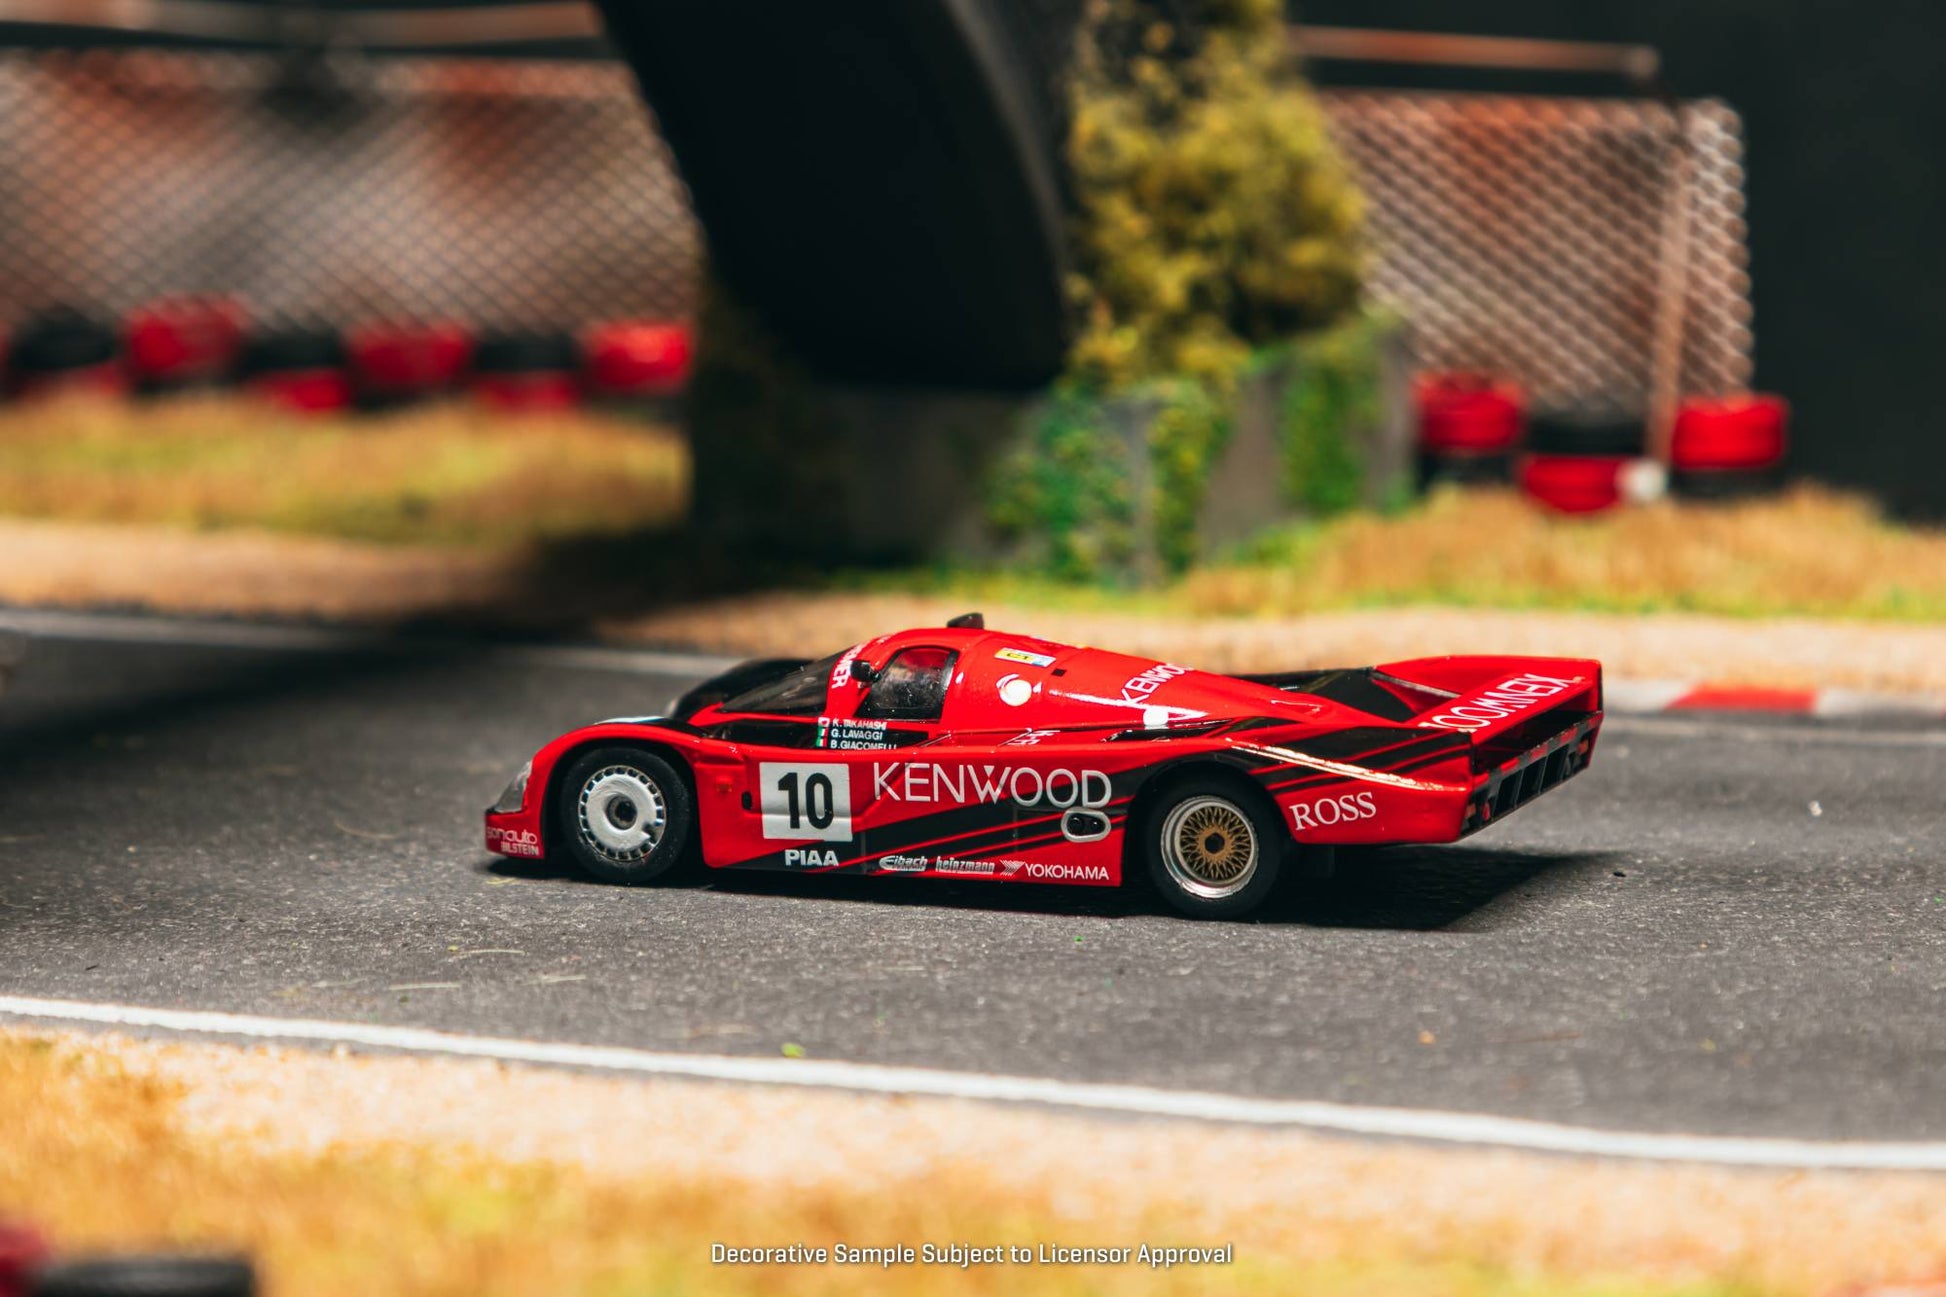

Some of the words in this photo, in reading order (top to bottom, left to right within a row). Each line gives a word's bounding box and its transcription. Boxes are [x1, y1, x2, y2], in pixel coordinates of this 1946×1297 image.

[842, 729, 883, 740] LAVAGGI
[873, 762, 1112, 809] KENWOOD
[778, 771, 834, 829] 10
[1289, 791, 1378, 830] ROSS
[784, 848, 839, 867] PIAA
[879, 855, 928, 871] Eibach
[1024, 863, 1110, 880] YOKOHAMA
